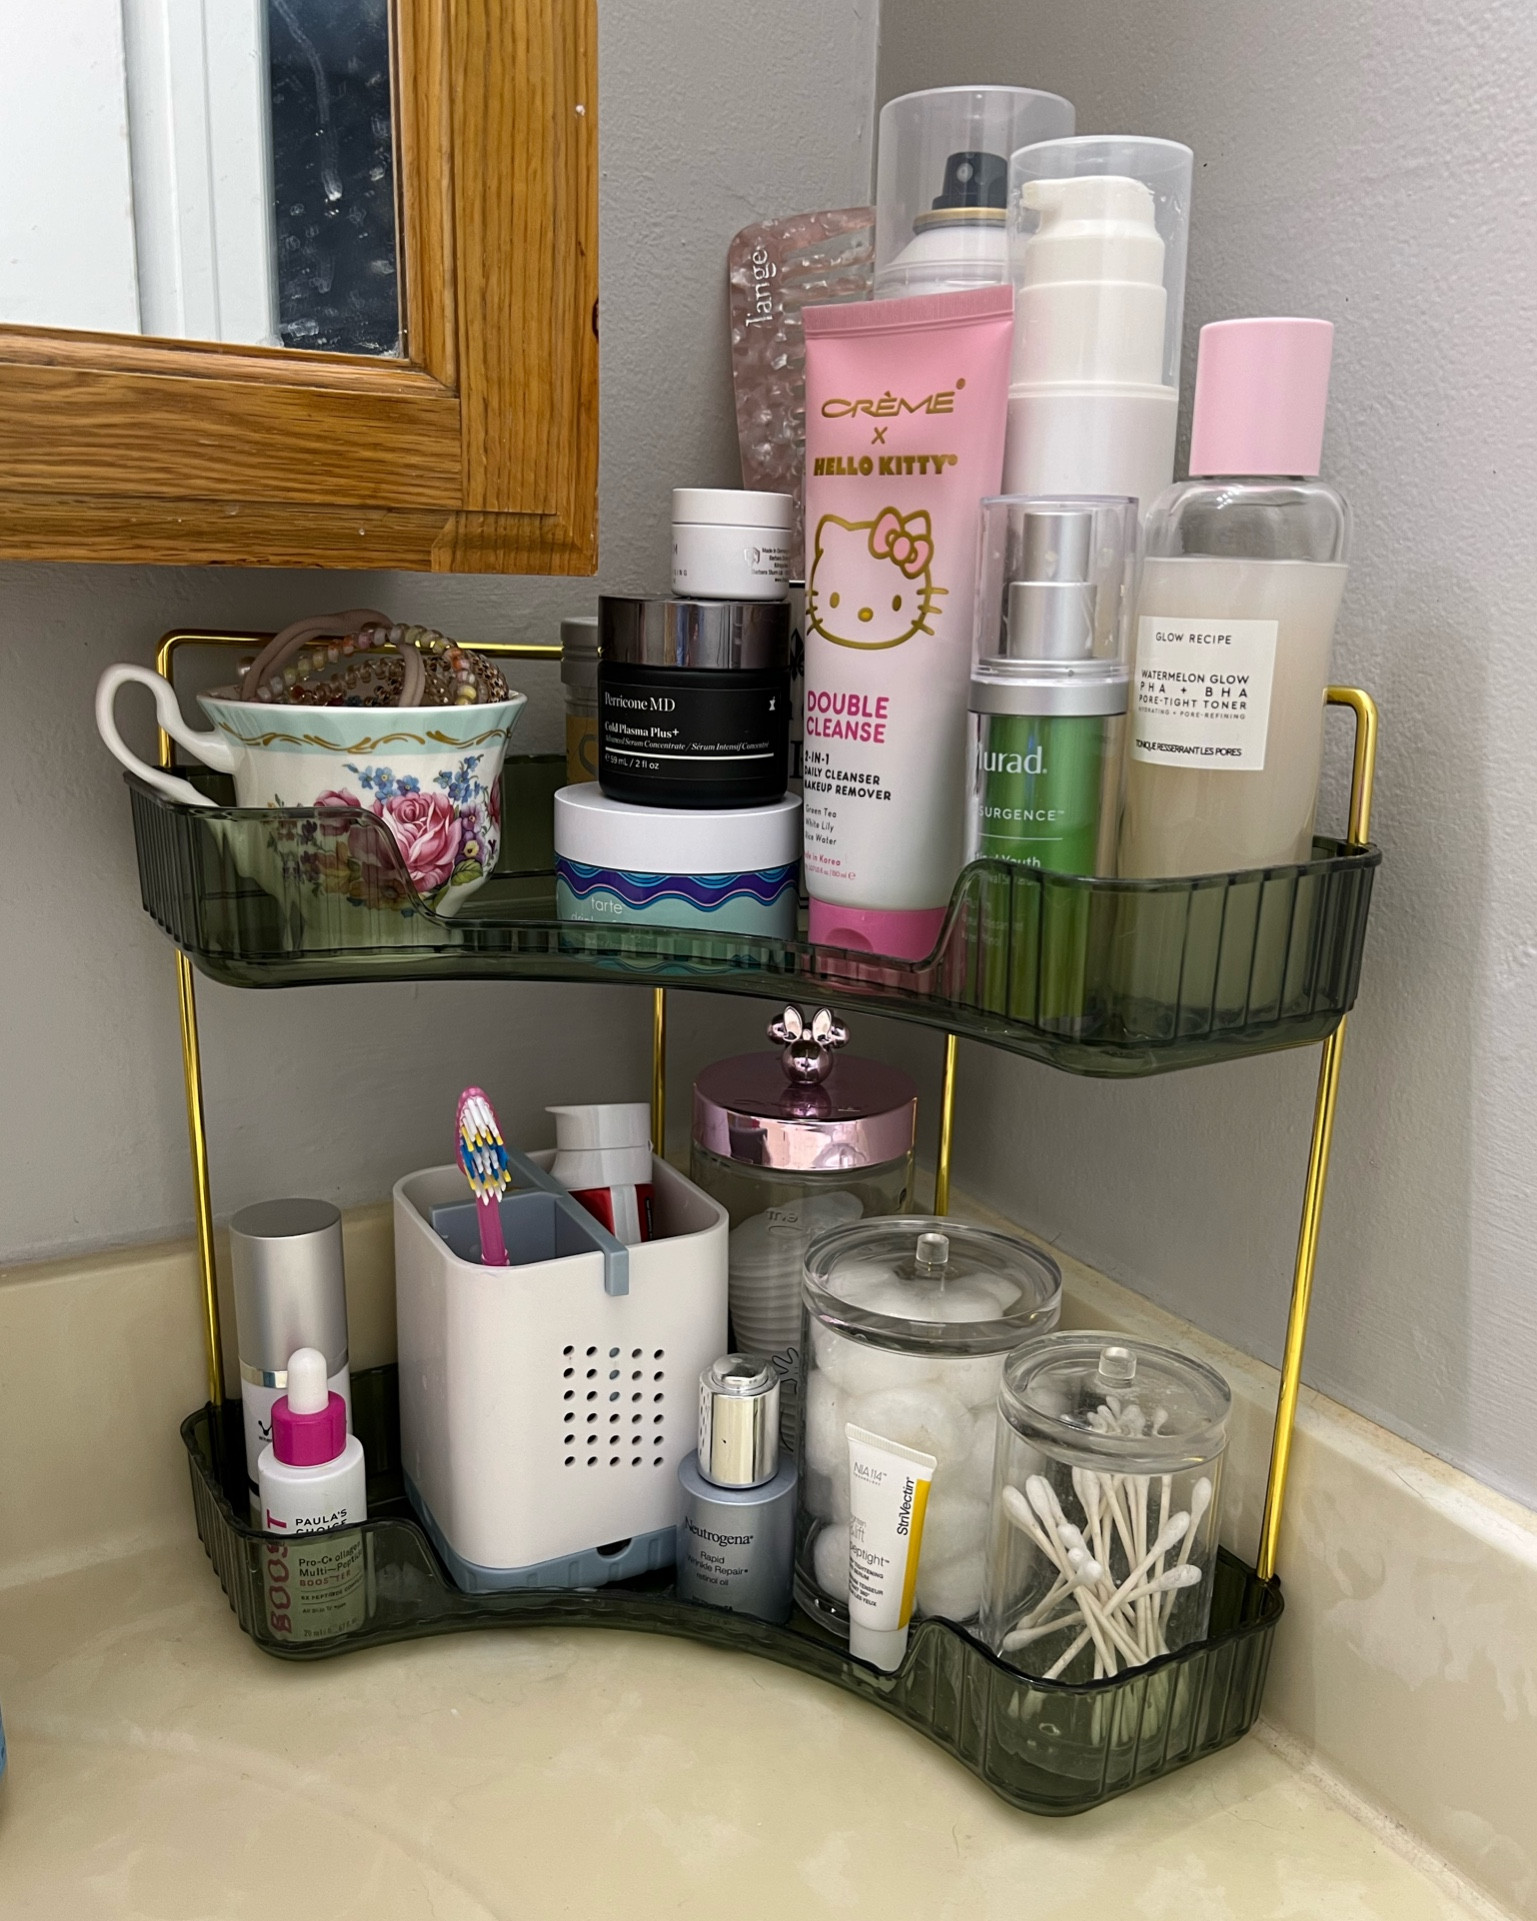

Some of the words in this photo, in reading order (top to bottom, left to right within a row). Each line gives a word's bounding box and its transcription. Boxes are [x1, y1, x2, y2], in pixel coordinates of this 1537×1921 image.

[813, 455, 873, 476] HELLO
[1156, 632, 1184, 642] GLOW
[1189, 634, 1232, 645] RECIPE
[1141, 669, 1205, 683] WATERMELON
[1209, 674, 1249, 685] GLOW
[604, 691, 648, 711] Perricone
[650, 697, 676, 712] MD
[807, 690, 890, 720] DOUBLE
[1139, 694, 1198, 709] PORE-TIGHT
[1203, 700, 1247, 710] TONER
[604, 720, 618, 733] Cold
[619, 723, 649, 737] Plasma
[650, 726, 680, 739] Plus+
[806, 716, 886, 744] CLEANSE
[644, 739, 686, 751] Concentrate
[1200, 748, 1214, 756] LES
[1215, 748, 1242, 757] PORES
[635, 758, 641, 768] 2
[649, 762, 659, 770] oz
[825, 769, 880, 786] CLEANSER
[835, 784, 891, 801] REMOVER
[823, 807, 837, 819] Tea
[978, 805, 1057, 822] SURGENCE
[821, 821, 834, 834] Lily
[815, 832, 837, 846] Water
[819, 854, 841, 867] Korea
[591, 896, 623, 915] tarte
[896, 1476, 916, 1537] StriVectin
[295, 1508, 348, 1526] PAULA'S
[684, 1515, 750, 1547] Neutrogena
[700, 1550, 725, 1564] Rapid
[714, 1565, 743, 1576] Repair
